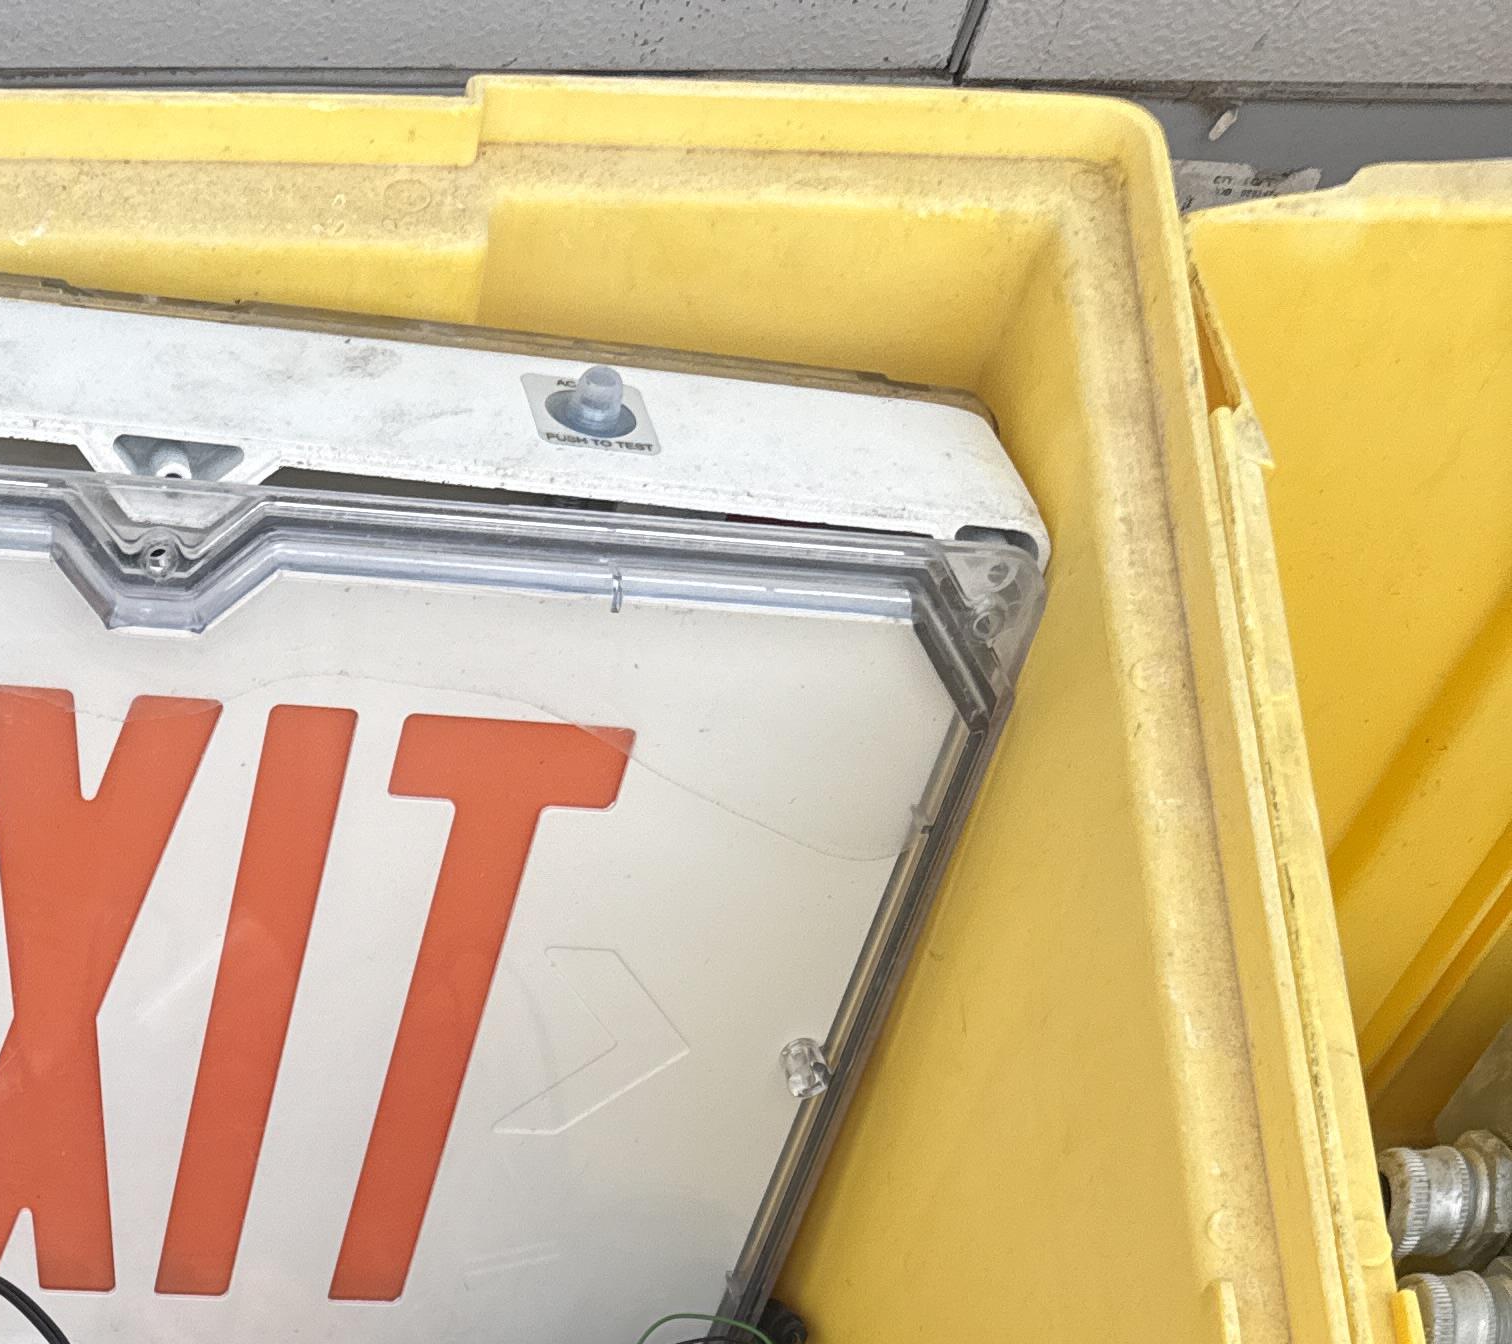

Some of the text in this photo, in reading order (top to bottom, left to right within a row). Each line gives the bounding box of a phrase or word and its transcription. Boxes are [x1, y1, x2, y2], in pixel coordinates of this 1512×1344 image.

[547, 433, 652, 451] PUSH TO TEST
